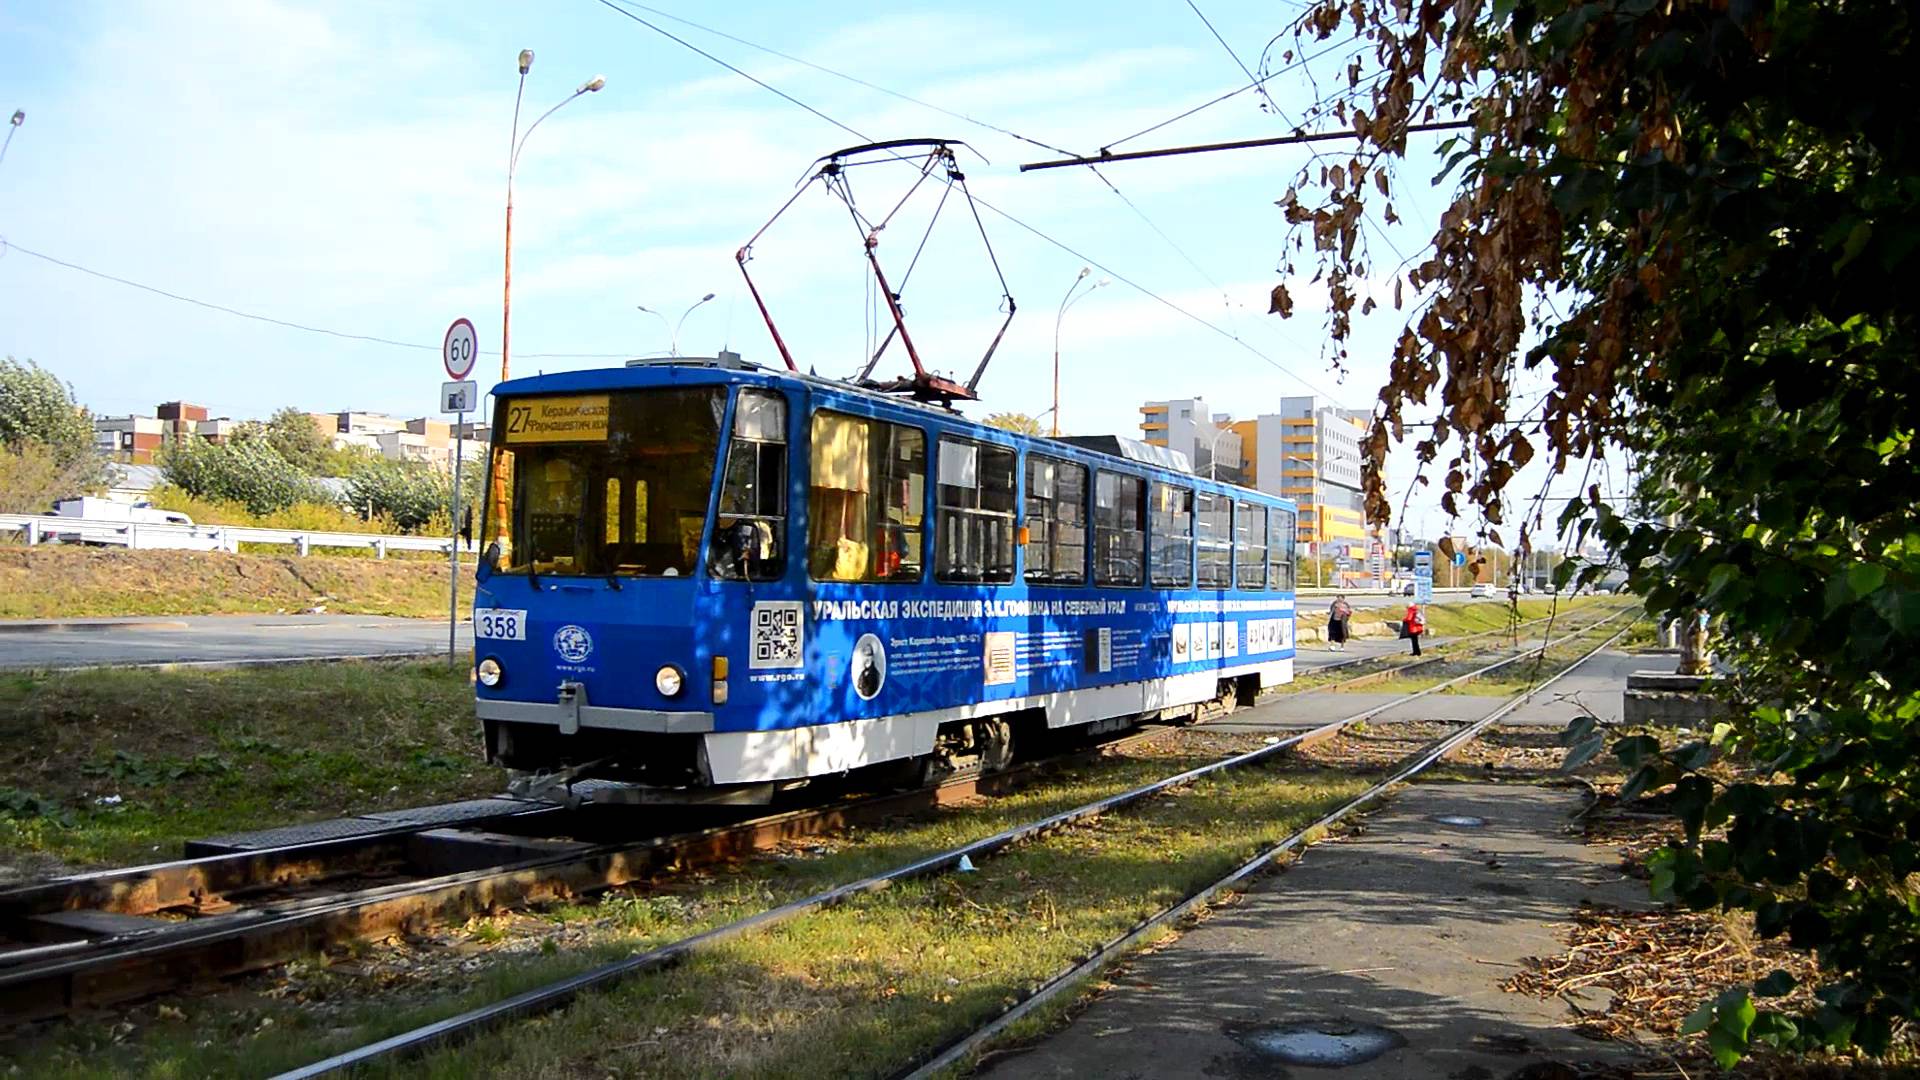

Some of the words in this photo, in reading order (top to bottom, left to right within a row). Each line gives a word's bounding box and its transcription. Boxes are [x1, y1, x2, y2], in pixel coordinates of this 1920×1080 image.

[451, 338, 470, 361] 60
[508, 407, 532, 433] 27
[813, 600, 898, 620] УРАЛЬСКАЯ
[902, 600, 983, 620] ЭКСПЕДИЦИЯ
[482, 616, 517, 638] 358
[749, 673, 805, 682] www.rgo.ru
